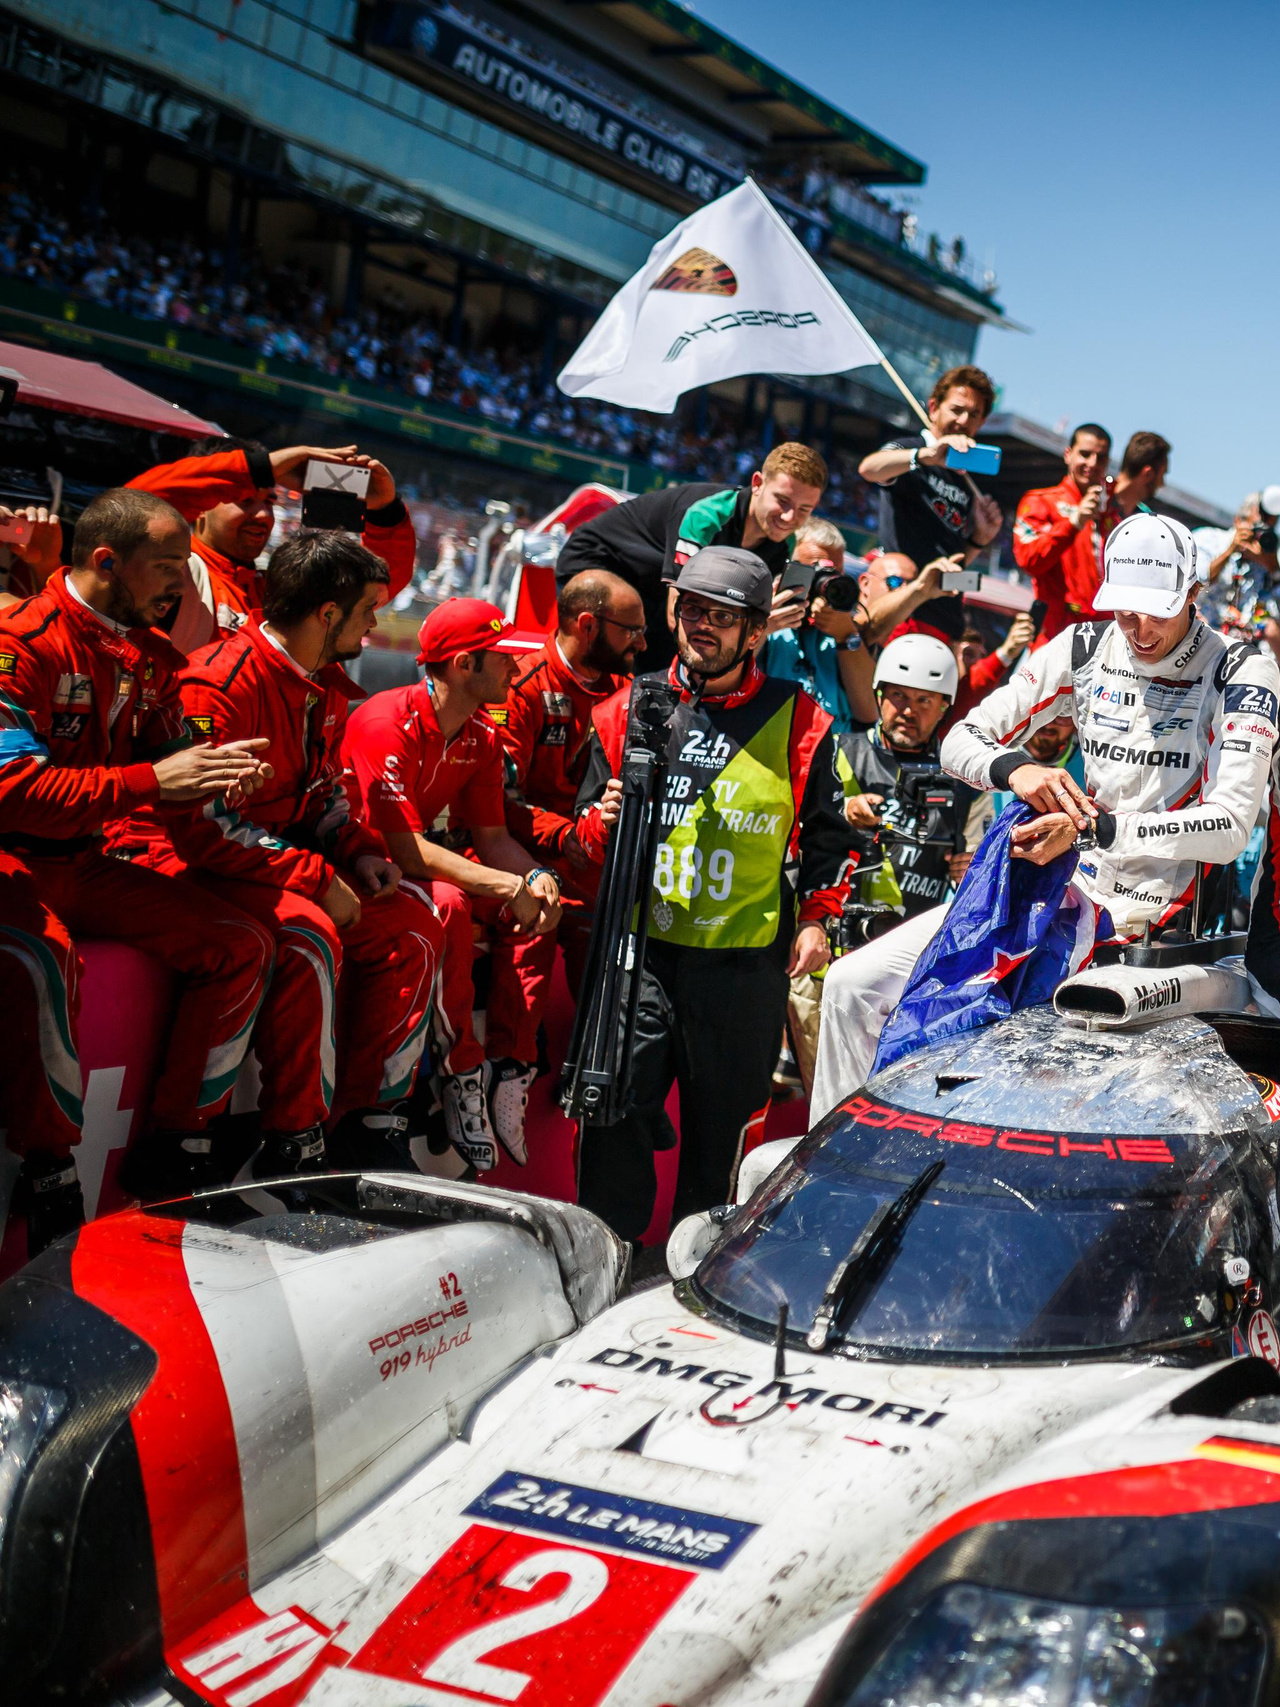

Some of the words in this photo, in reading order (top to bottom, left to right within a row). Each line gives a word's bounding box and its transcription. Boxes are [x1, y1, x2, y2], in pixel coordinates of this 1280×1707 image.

[452, 43, 623, 151] AUTOMOBILE
[622, 131, 685, 183] CLUB
[686, 168, 719, 200] DE
[1113, 557, 1135, 565] Porsche
[1137, 558, 1153, 566] LMP
[1155, 559, 1172, 569] Team
[1249, 705, 1271, 717] MANS
[679, 753, 695, 762] LE
[694, 755, 727, 766] MANS
[715, 780, 741, 803] TV
[718, 808, 782, 835] TRACK
[1137, 822, 1180, 838] DMG
[1184, 816, 1232, 834] MORI
[653, 843, 735, 901] 889
[899, 845, 922, 868] TV
[1113, 881, 1163, 905] Brendon
[1134, 980, 1170, 1013] Mobil
[835, 1096, 1175, 1163] PORSCHE
[439, 1272, 463, 1301] #2
[368, 1300, 469, 1355] PORSCHE
[379, 1350, 412, 1382] 919
[415, 1322, 472, 1374] hybrid
[587, 1347, 752, 1389] DMG
[756, 1379, 950, 1429] MORI
[566, 1503, 623, 1529] LE
[613, 1513, 731, 1554] MANS
[423, 1549, 610, 1701] 2
